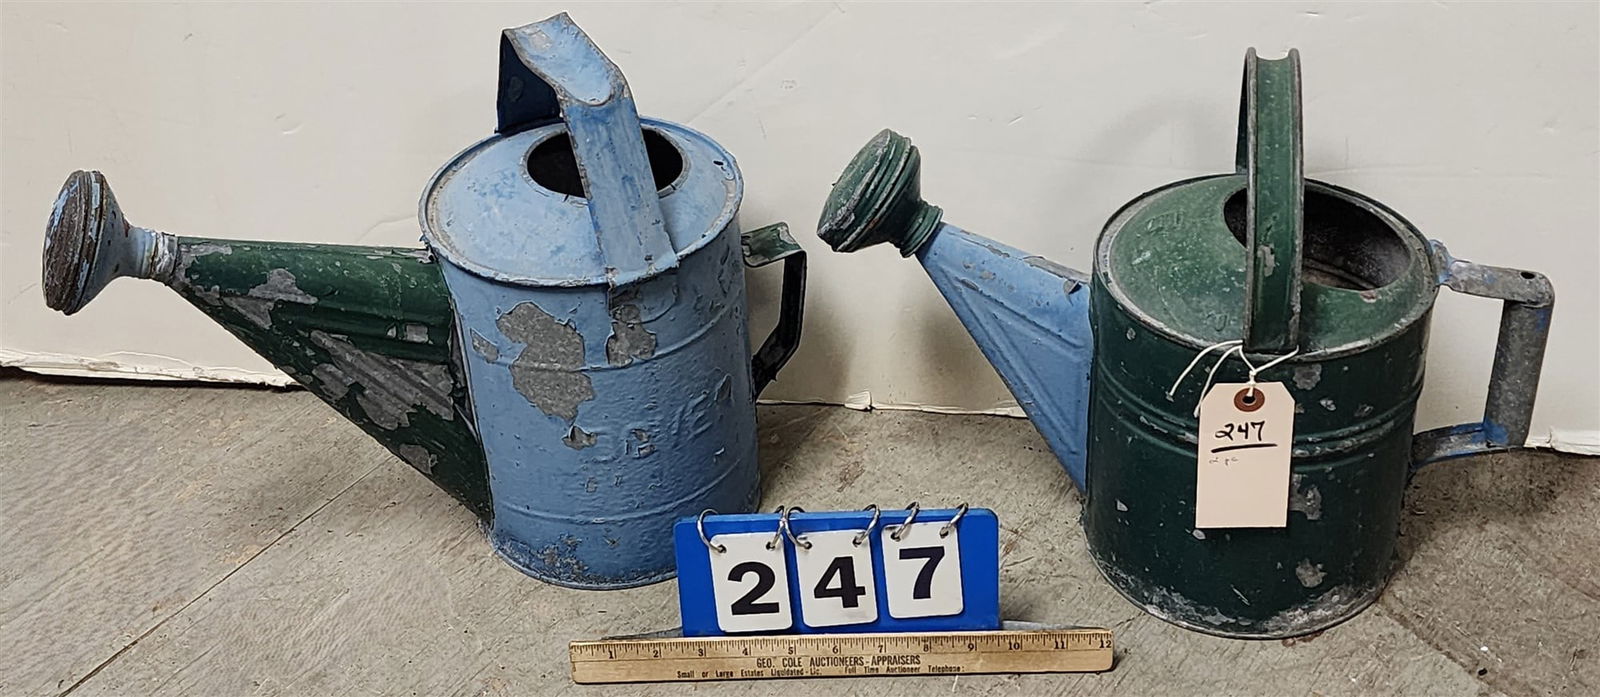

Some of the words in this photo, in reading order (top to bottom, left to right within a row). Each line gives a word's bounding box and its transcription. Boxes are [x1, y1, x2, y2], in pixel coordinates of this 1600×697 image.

[1215, 420, 1266, 442] 247
[727, 561, 780, 616] 2
[813, 555, 866, 609] 4
[898, 546, 945, 600] 7
[1008, 641, 1020, 650] 10
[1053, 640, 1066, 650] 11
[1099, 639, 1112, 649] 12
[756, 657, 775, 669] GEO.
[782, 657, 803, 668] COLE
[677, 670, 695, 679] Small
[715, 669, 734, 679] Large
[740, 669, 764, 677] Estates
[844, 666, 857, 674] Full
[864, 666, 879, 674] Time
[885, 665, 921, 674] Auctioneer
